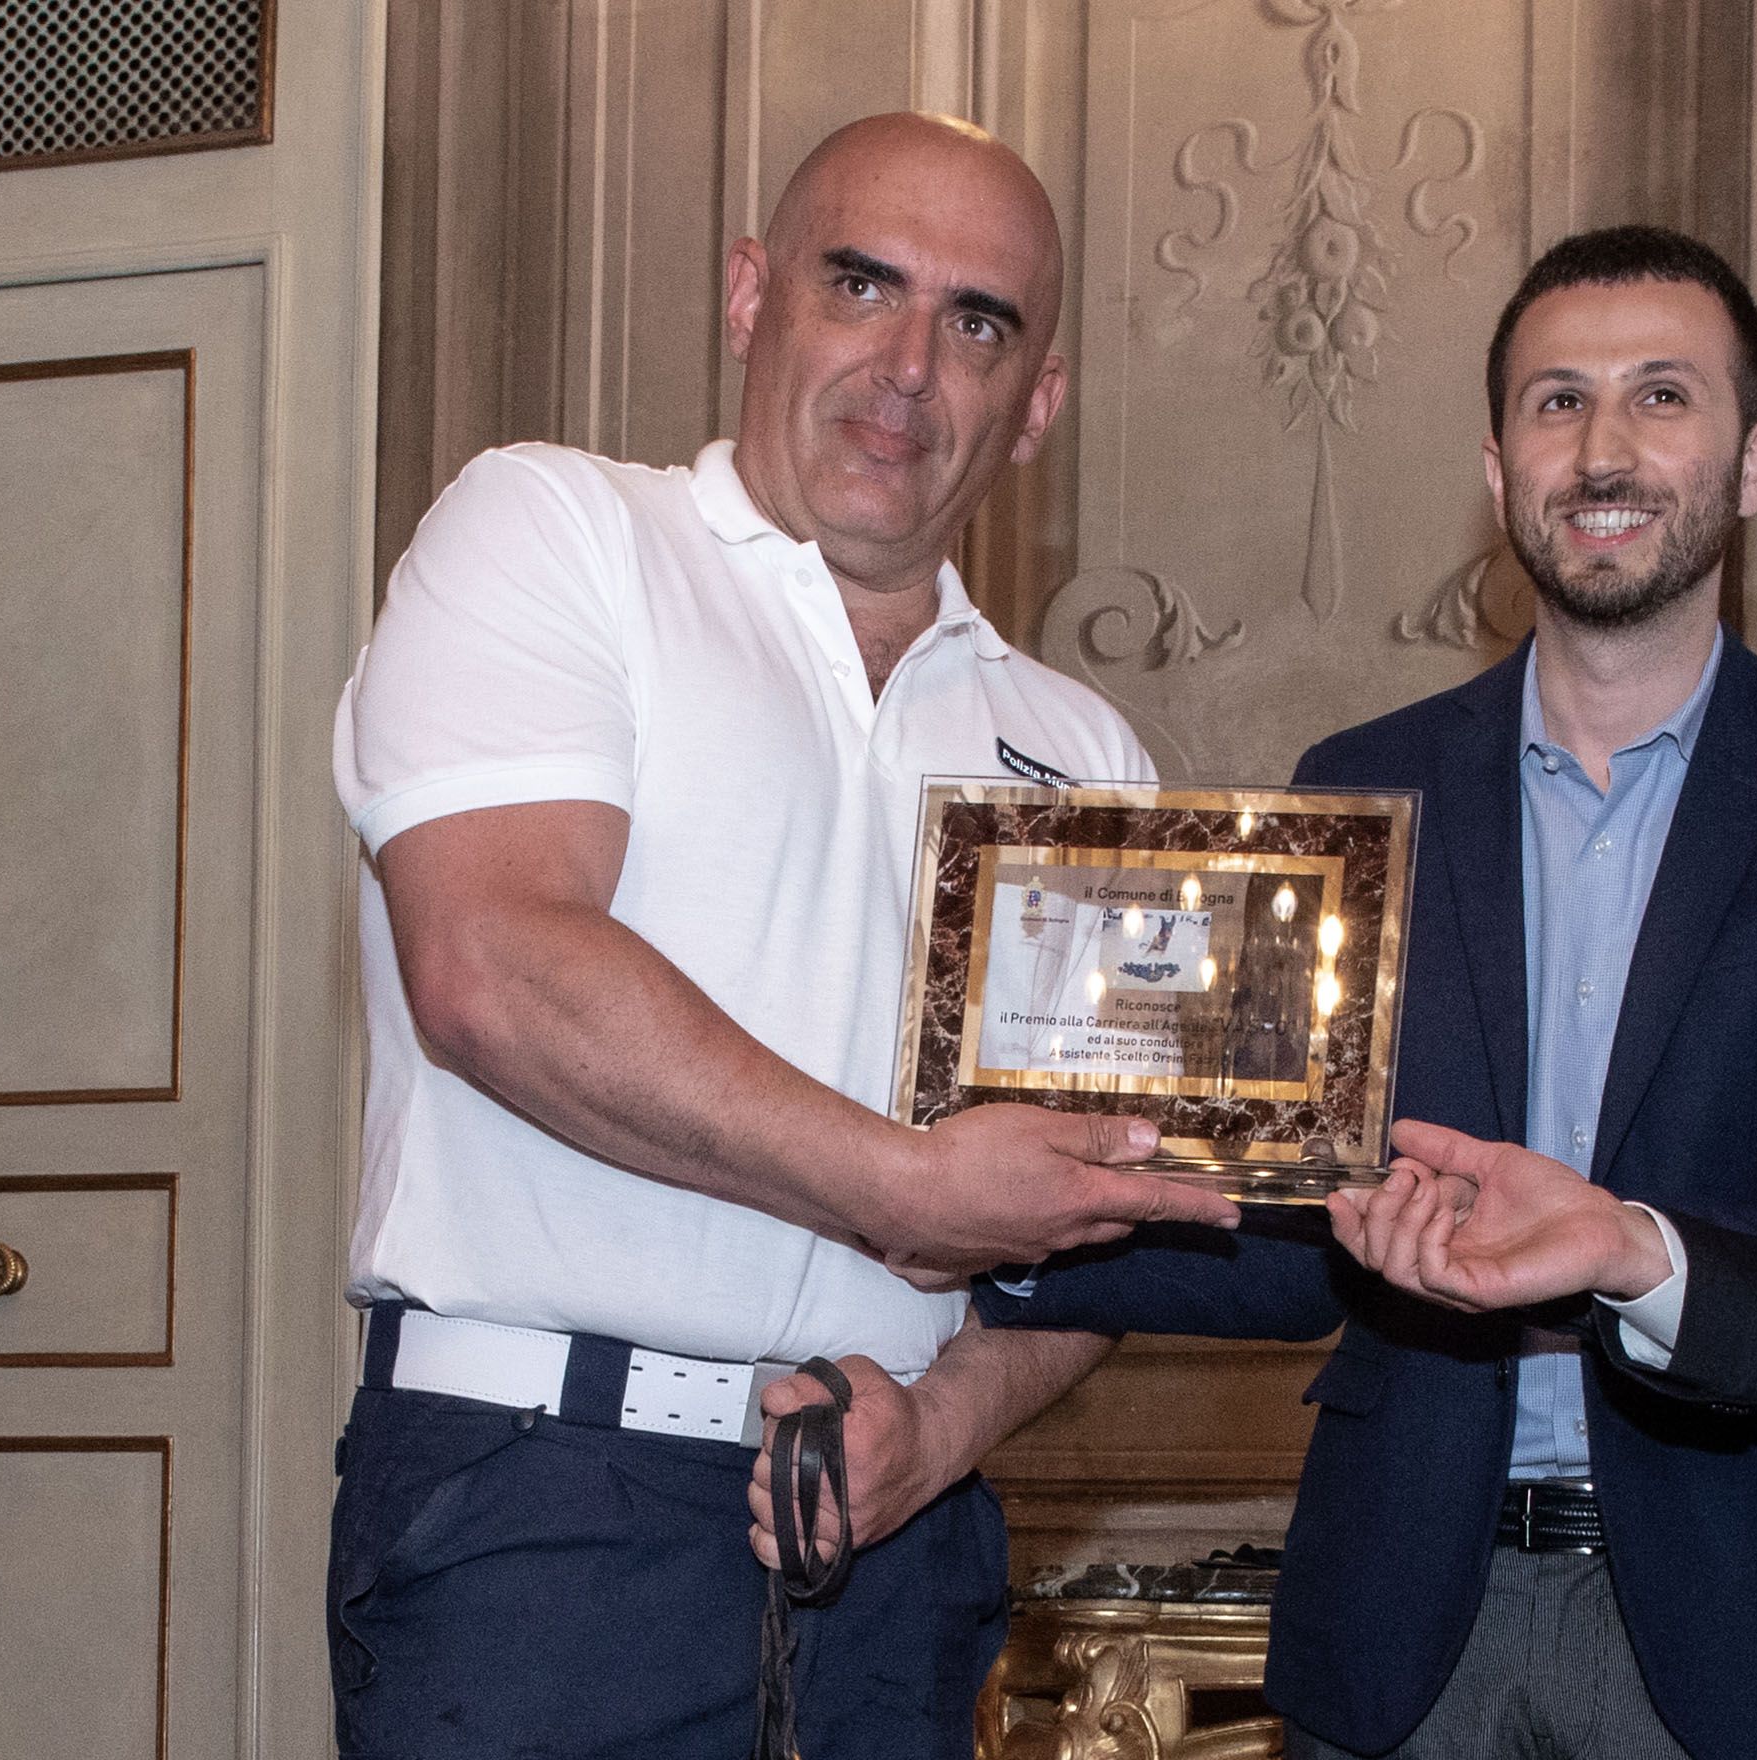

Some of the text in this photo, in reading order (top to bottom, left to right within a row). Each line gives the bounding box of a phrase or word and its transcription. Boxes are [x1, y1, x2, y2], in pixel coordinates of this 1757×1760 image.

[1002, 748, 1075, 790] Polizia Mun
[1084, 886, 1234, 906] il Comune di Bogna
[1115, 999, 1181, 1012] Riconosce
[999, 1011, 1008, 1024] il
[1010, 1012, 1057, 1026] Premio
[1059, 1015, 1083, 1027] alla
[1086, 1016, 1141, 1030] Carriera
[1087, 1034, 1204, 1048] ed al suo conduttore
[1049, 1048, 1111, 1061] Assistente
[1113, 1050, 1149, 1062] Scelto
